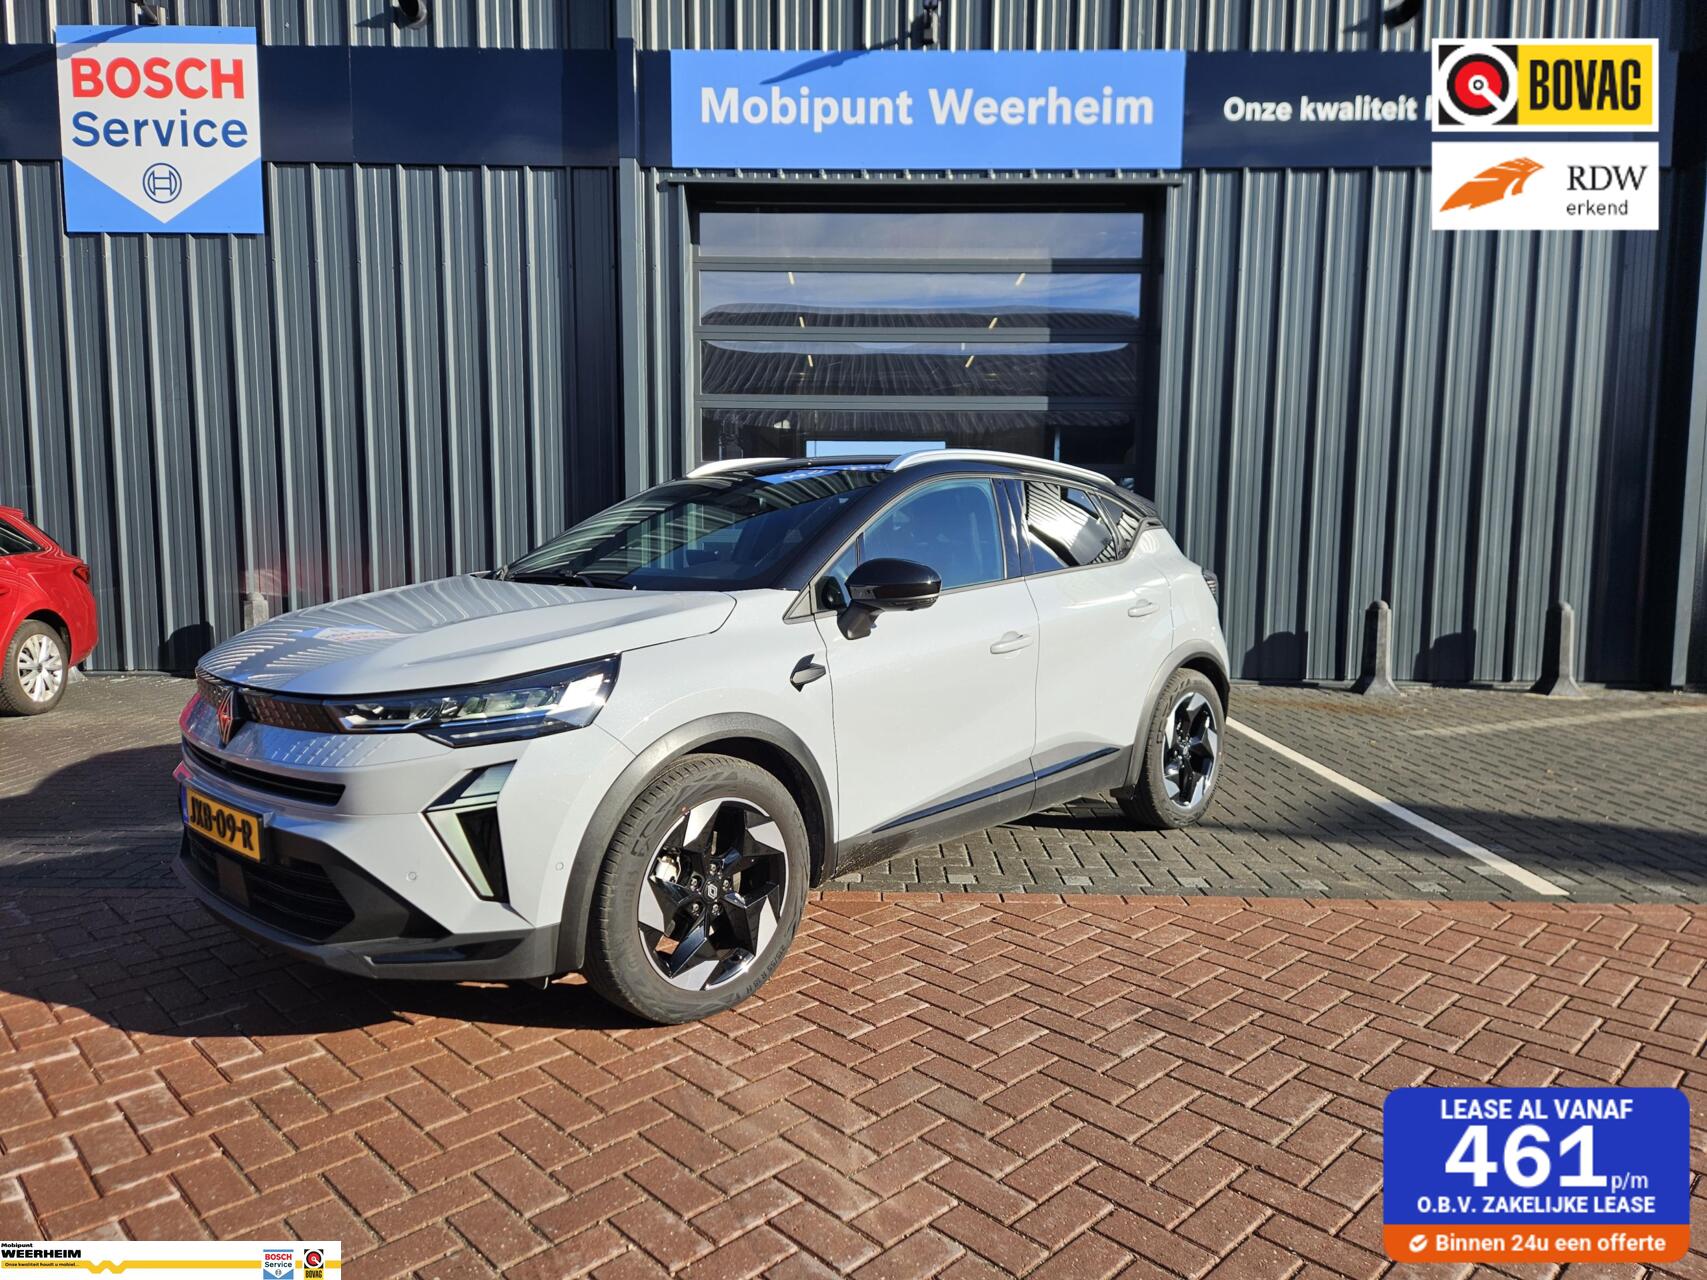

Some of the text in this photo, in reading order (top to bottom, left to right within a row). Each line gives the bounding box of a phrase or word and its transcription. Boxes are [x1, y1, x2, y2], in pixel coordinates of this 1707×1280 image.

[71, 57, 245, 99] BOSCH
[701, 86, 1154, 132] Mobipunt Weerheim
[1224, 96, 1293, 121] Onze
[1300, 95, 1418, 121] kwaliteit
[72, 109, 248, 148] Service
